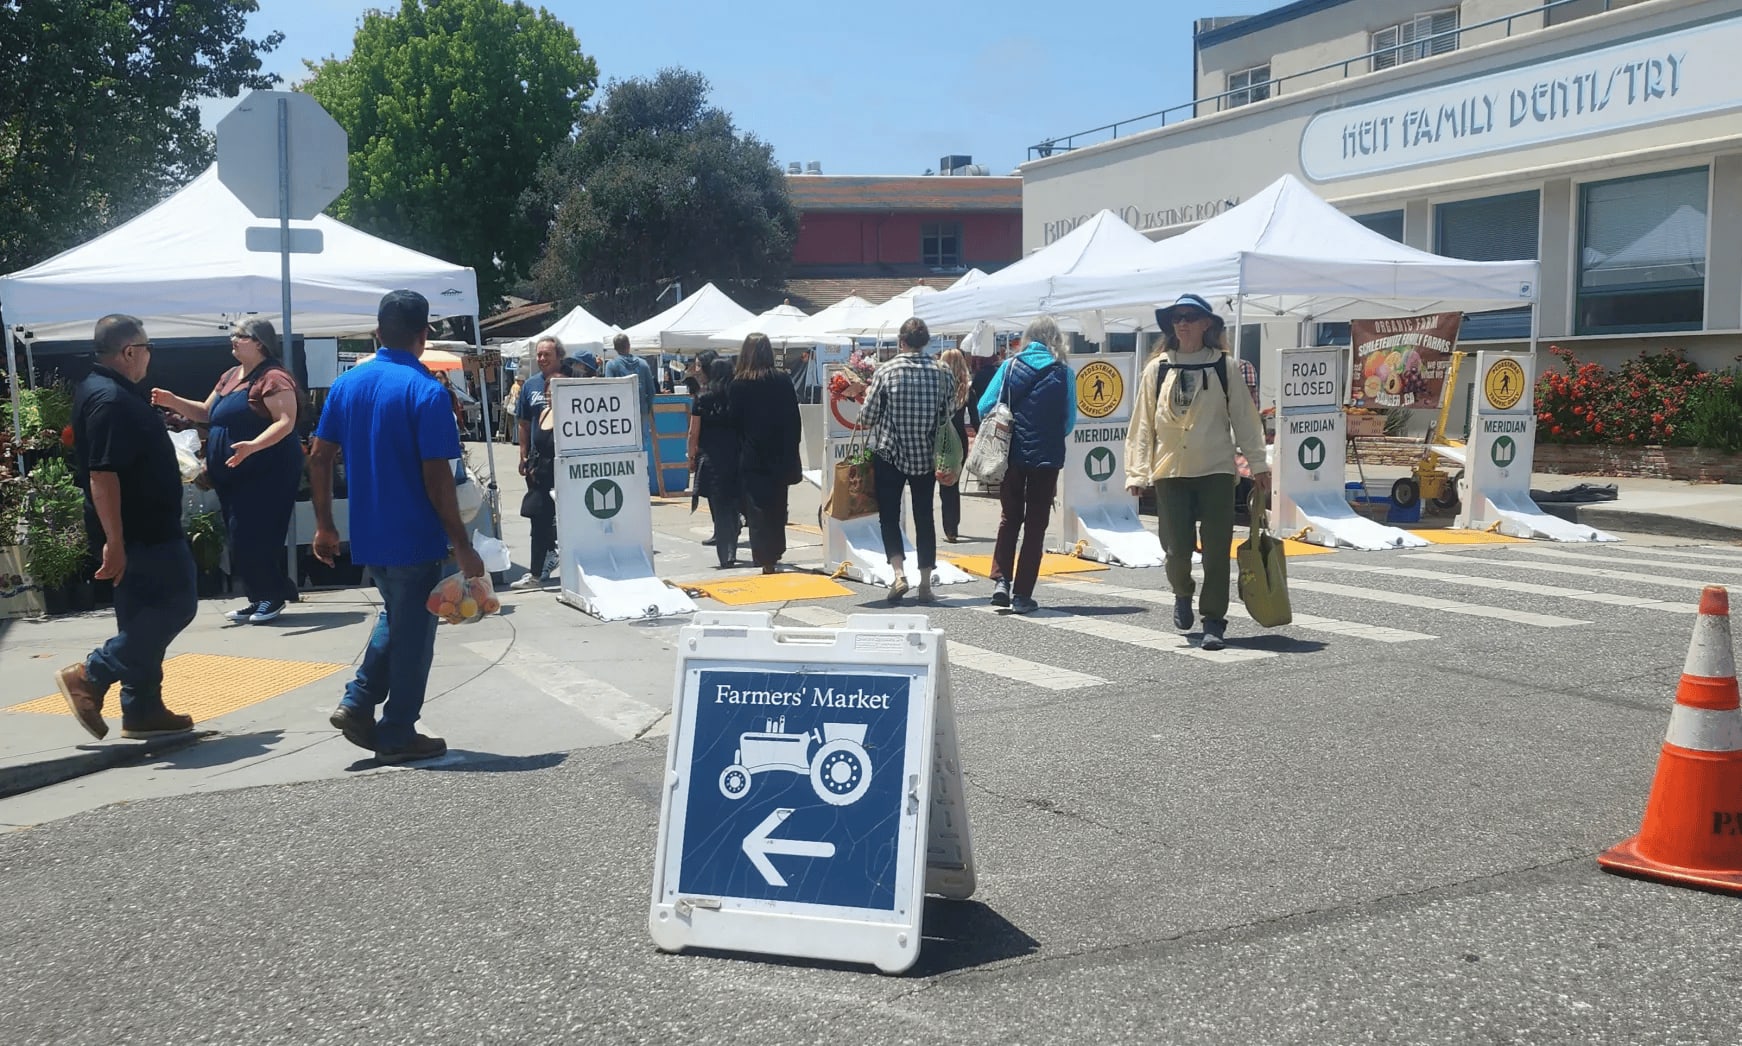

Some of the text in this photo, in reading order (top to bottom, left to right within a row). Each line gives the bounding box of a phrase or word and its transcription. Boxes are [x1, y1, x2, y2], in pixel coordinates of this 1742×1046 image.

[1342, 51, 1688, 160] HEIT FAMILY DENTISTRY
[1143, 205, 1193, 229] TASTING
[1374, 314, 1439, 333] ORGANIC FARM
[1423, 334, 1451, 353] FARMS
[1080, 364, 1117, 379] PEDESTRIAN
[1292, 362, 1327, 377] ROAD
[1284, 381, 1334, 397] CLOSED
[571, 396, 621, 414] ROAD
[1079, 398, 1118, 415] TRAFFIC ONLY
[562, 418, 632, 438] CLOSED
[1074, 427, 1128, 443] MERIDIAN
[1290, 418, 1335, 435] MERIDIAN
[1484, 420, 1527, 433] MERIDIAN
[569, 460, 635, 480] MERIDIAN
[714, 684, 890, 710] Farmers' Market
